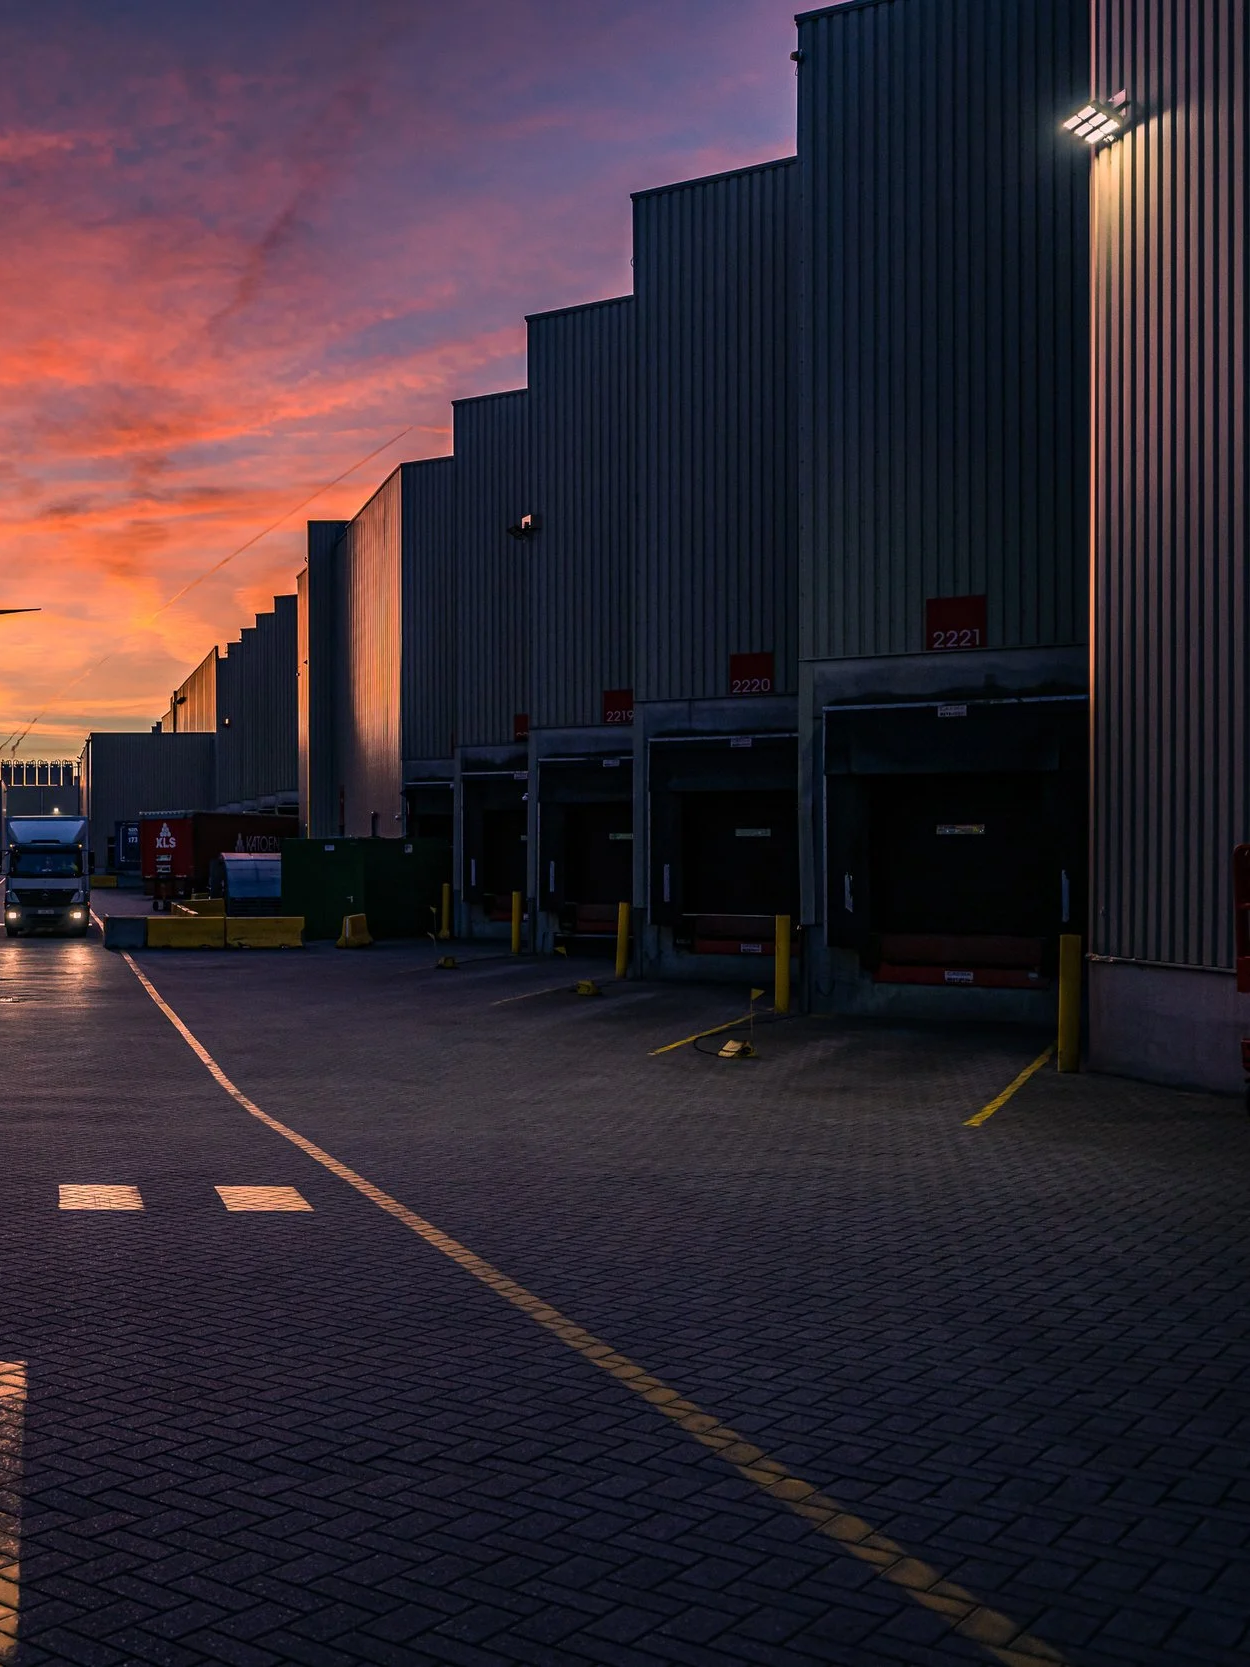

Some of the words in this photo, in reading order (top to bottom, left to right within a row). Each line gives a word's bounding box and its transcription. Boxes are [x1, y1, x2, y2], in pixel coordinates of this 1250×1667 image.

[932, 628, 980, 649] 2221
[732, 678, 771, 693] 2220
[606, 710, 634, 722] 2219
